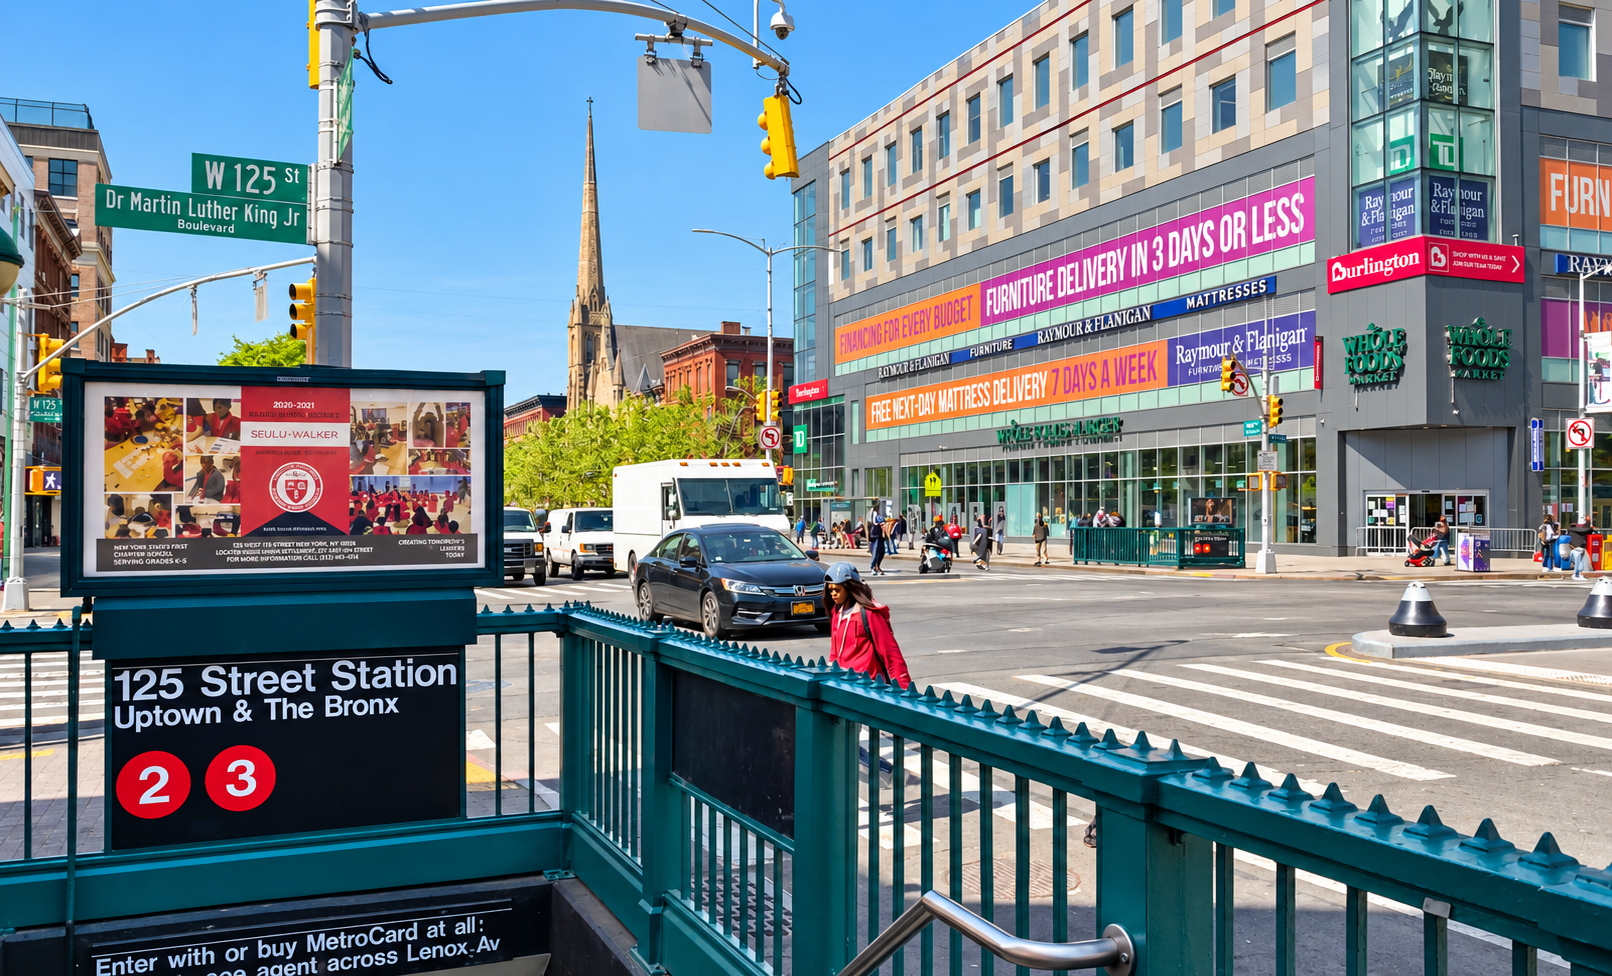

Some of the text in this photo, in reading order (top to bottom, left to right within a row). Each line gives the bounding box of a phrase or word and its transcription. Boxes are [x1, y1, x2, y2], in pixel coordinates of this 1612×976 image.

[205, 160, 300, 195] W 125 St
[106, 189, 300, 229] Dr Martin Luther King Jr
[177, 219, 235, 233] Boulevard
[986, 192, 1305, 317] FURNITURE DELIVERY IN 3 DAYS OR LESS
[1331, 251, 1420, 282] Burlington
[840, 294, 973, 356] FINANCING FOR EVERY BUDGET
[1037, 279, 1268, 345] RAYMOUR & FLANIGAN MATTRESSES
[915, 352, 950, 371] FLANIGAN
[970, 339, 1013, 358] FURNITURE
[1175, 341, 1231, 367] Raymour
[1232, 334, 1244, 354] &
[1246, 327, 1307, 353] Flanigan
[1341, 328, 1407, 355] WHOLE
[1446, 325, 1513, 349] WHOLE
[1344, 350, 1403, 375] FOODS
[1450, 345, 1511, 369] FOODS
[871, 400, 891, 424] FREE
[893, 390, 936, 420] NEXT-DAY
[938, 380, 991, 415] MATTRESS
[993, 370, 1048, 406] DELIVERY
[1052, 368, 1059, 396] 7
[1063, 360, 1097, 395] DAYS
[1100, 359, 1110, 389] A
[1115, 349, 1158, 386] WEEK
[113, 657, 458, 702] 125 Street Station
[113, 694, 400, 733] Uptown & The Bronx
[138, 759, 257, 805] 2 3
[96, 955, 158, 976] Enter
[167, 946, 215, 969] with
[224, 945, 248, 962] or
[257, 939, 298, 960] buy
[306, 922, 418, 953] MetroCard
[426, 920, 446, 939] at
[256, 956, 318, 976] agent
[326, 950, 398, 972] across
